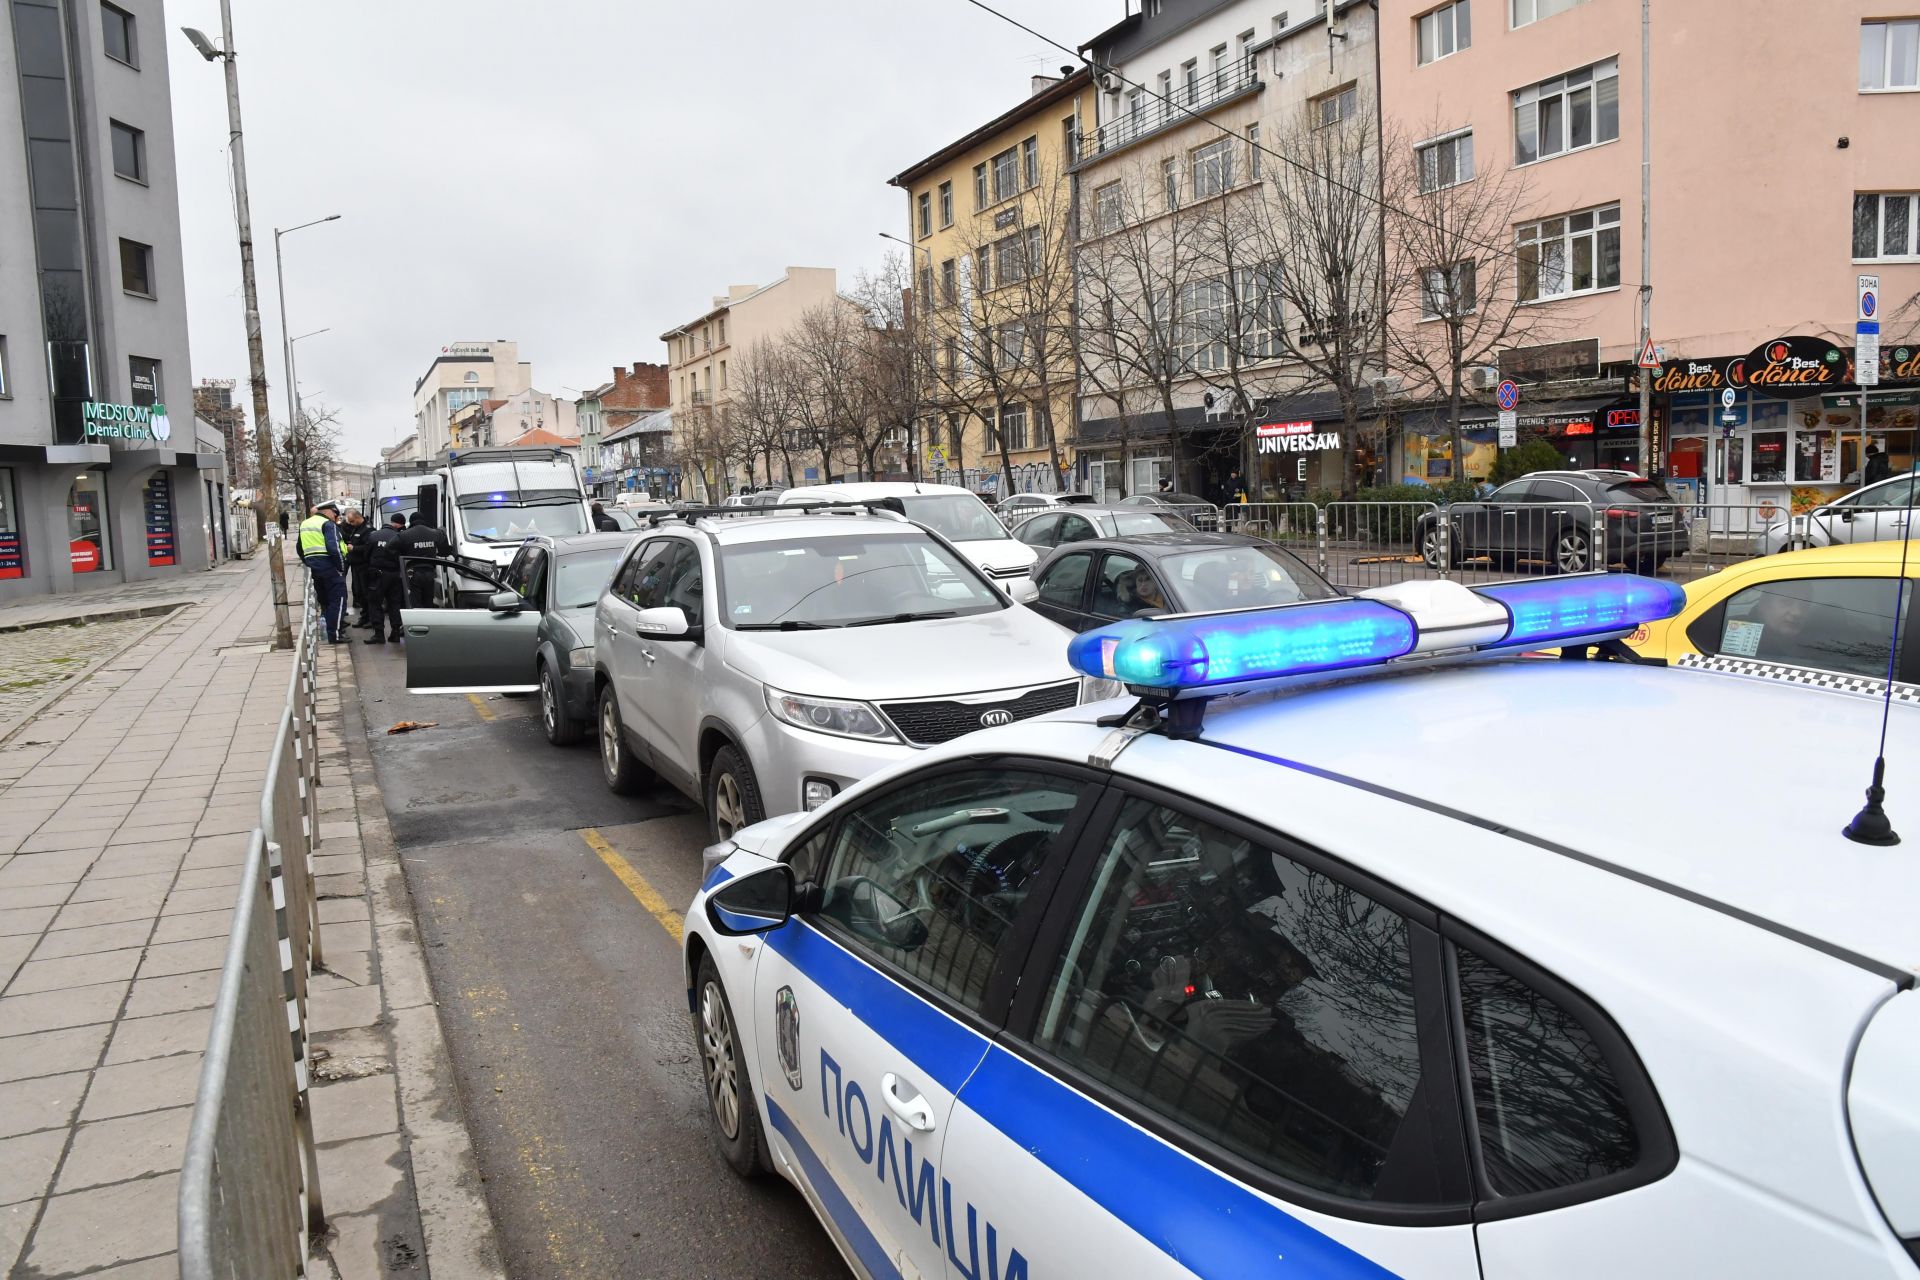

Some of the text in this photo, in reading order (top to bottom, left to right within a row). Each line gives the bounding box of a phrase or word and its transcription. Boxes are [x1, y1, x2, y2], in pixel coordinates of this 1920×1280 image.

[1860, 279, 1878, 288] ЗОНА
[1688, 361, 1712, 375] Best
[1791, 357, 1820, 370] Best
[1654, 367, 1725, 393] döner
[1749, 361, 1835, 386] döner
[86, 402, 149, 423] MEDSTOM
[1609, 411, 1640, 426] OPEN
[1517, 417, 1545, 426] AVENUE
[88, 422, 151, 440] Dental Clinic
[1256, 423, 1312, 437] Premium Market
[1257, 432, 1340, 454] UNIVERSAM
[985, 712, 1009, 725] KIA
